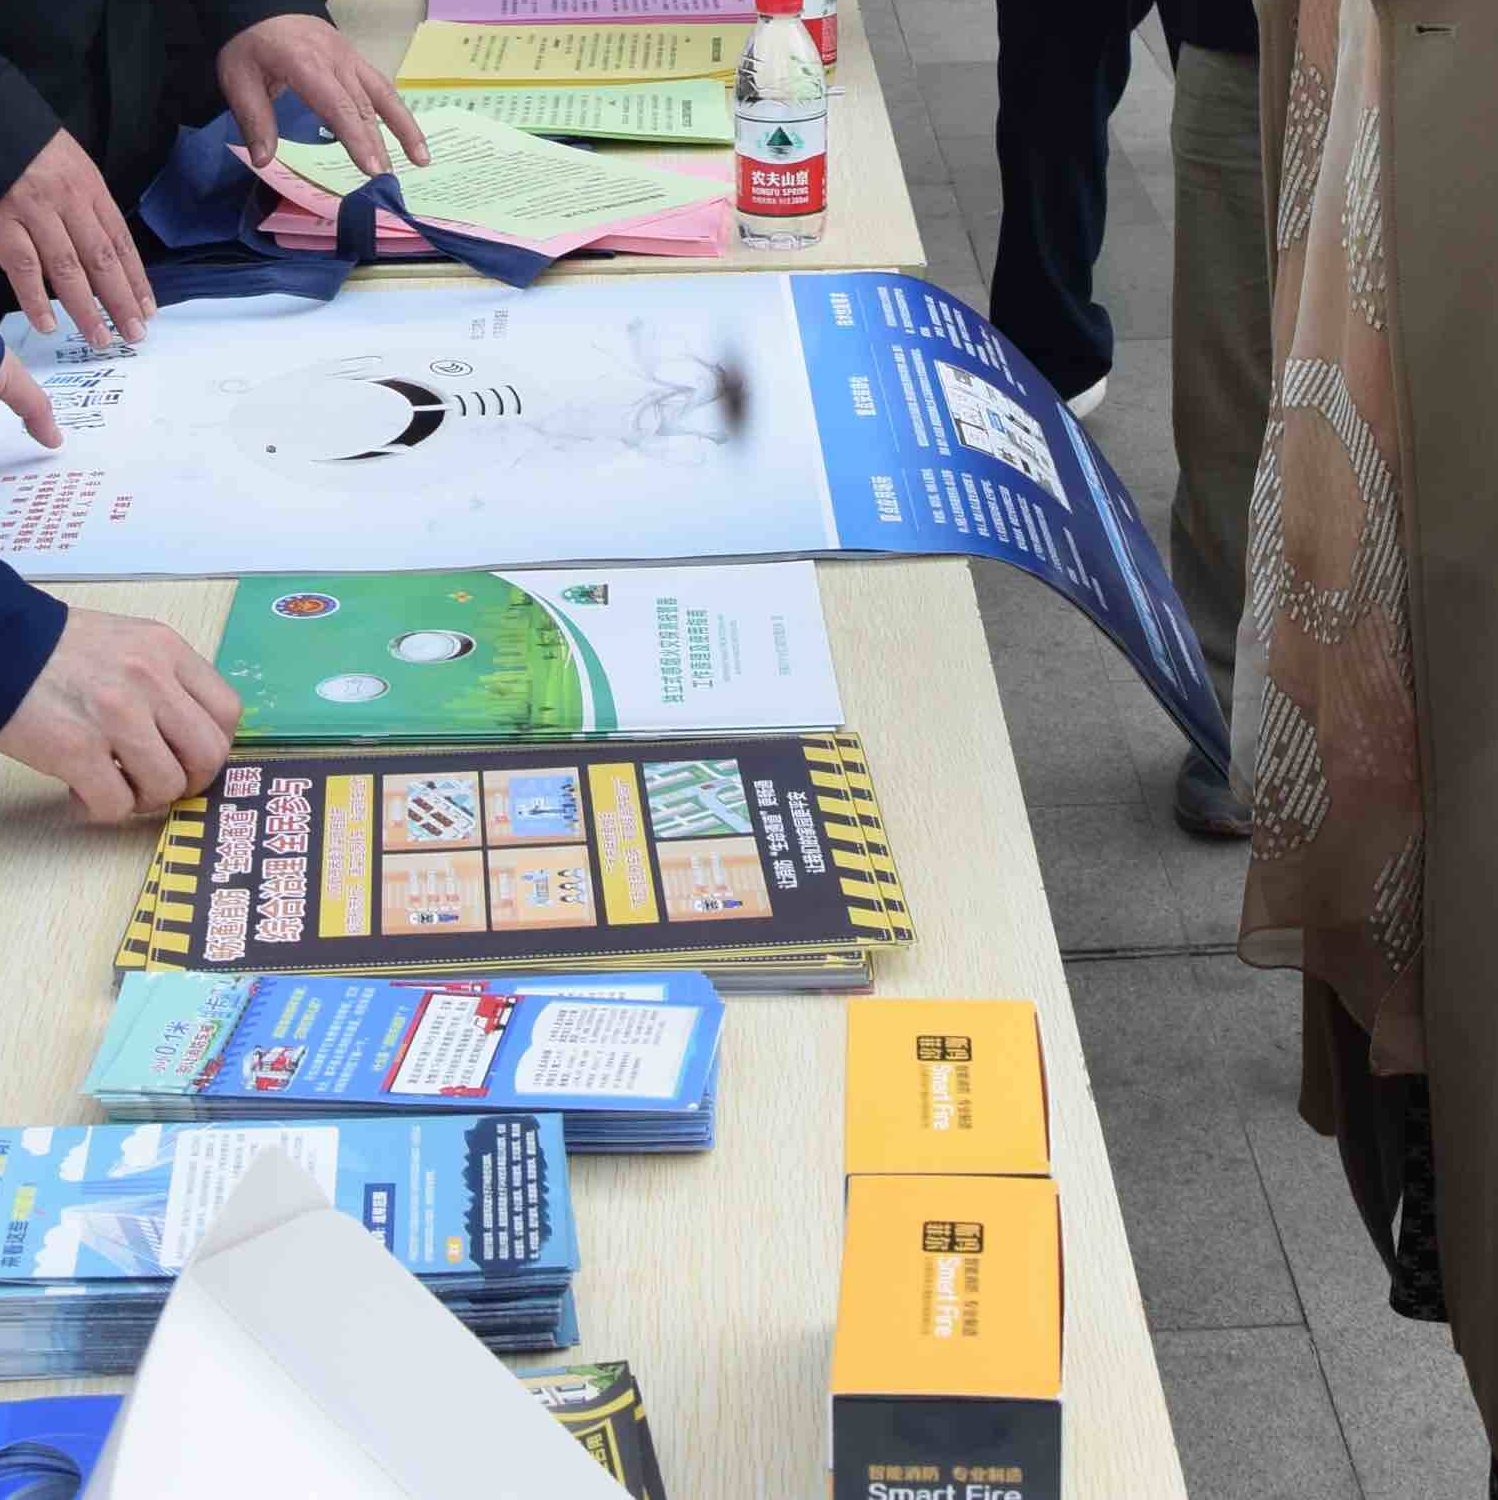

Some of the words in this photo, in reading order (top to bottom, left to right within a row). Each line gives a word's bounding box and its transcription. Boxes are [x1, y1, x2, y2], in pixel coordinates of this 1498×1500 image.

[751, 169, 810, 187] 农夫山泉
[935, 1256, 962, 1300] Smart
[934, 1306, 961, 1337] Fire
[868, 1483, 956, 1500] Smart
[965, 1484, 1022, 1500] Fire
